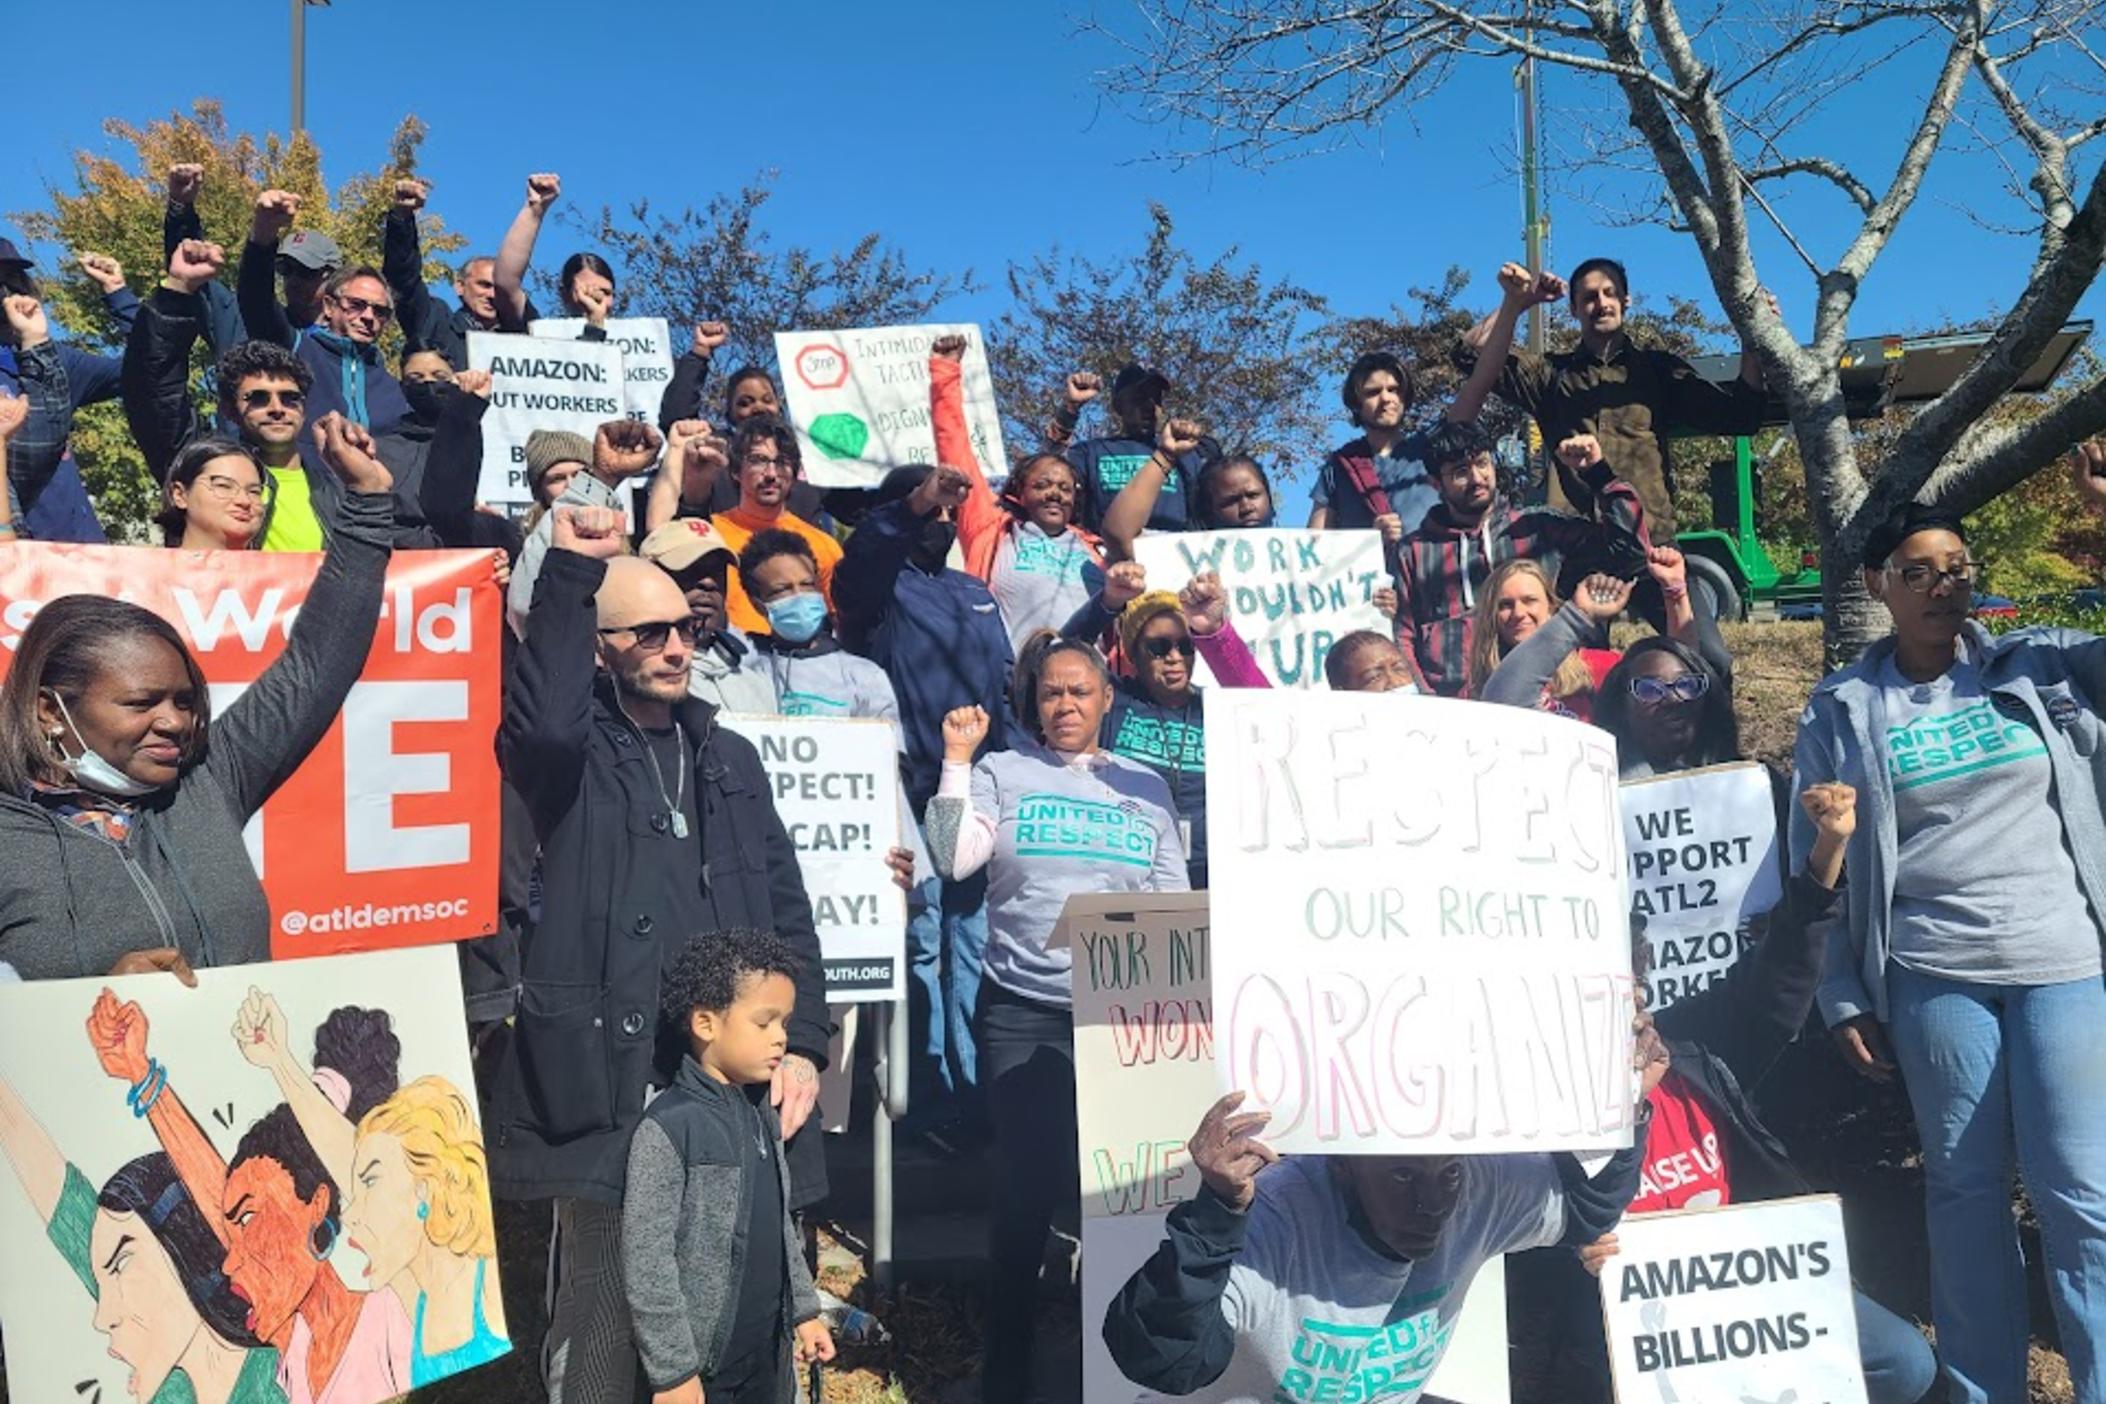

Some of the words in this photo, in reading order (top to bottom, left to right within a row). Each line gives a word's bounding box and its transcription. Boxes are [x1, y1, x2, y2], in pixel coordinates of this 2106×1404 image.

[490, 356, 607, 383] AMAZON:
[624, 367, 668, 382] KERS
[490, 391, 519, 408] UT
[524, 393, 618, 414] WORKERS
[1176, 537, 1323, 574] WORK
[1223, 570, 1378, 621] OULDN'T
[760, 735, 818, 763] NO
[769, 772, 874, 801] PECT!
[1234, 701, 1617, 880] RESPECT
[1018, 804, 1124, 826] UNITED
[1635, 807, 1694, 840] WE
[1015, 824, 1152, 856] RESPECT
[1627, 836, 1752, 880] PPORT
[814, 895, 879, 925] AY!
[1305, 886, 1410, 940] OUR
[1439, 885, 1549, 939] RIGHT
[1562, 895, 1600, 940] TO
[1630, 879, 1718, 915] ATL2
[281, 898, 469, 936] @atldemsoc
[1080, 931, 1150, 992] YOUR
[1619, 1241, 1831, 1302] AMAZON'S
